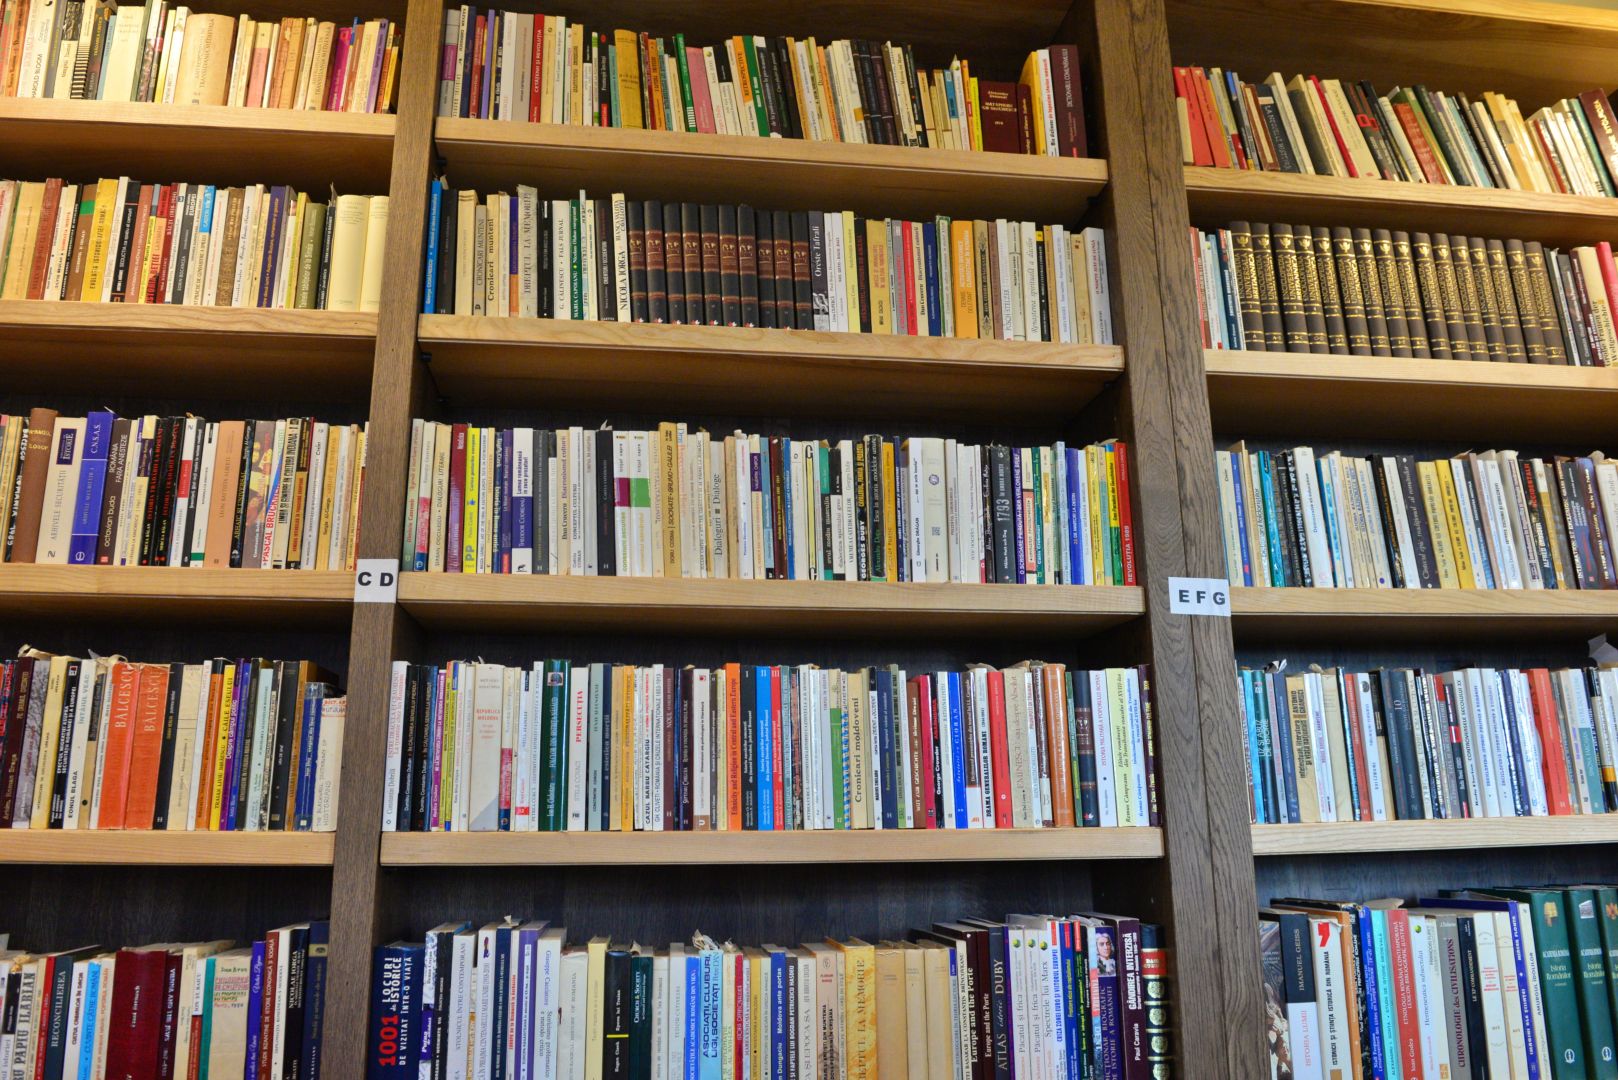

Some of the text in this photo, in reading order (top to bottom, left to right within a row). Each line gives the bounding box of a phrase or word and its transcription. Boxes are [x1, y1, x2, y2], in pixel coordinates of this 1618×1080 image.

[618, 251, 626, 276] IORGA
[812, 226, 822, 277] Oreste Tafrali
[90, 423, 101, 454] C.N.S.A.S.
[104, 496, 116, 547] octavian buda
[712, 473, 723, 555] Dialoguri Dialoge
[996, 498, 1009, 522] 1793
[1542, 548, 1550, 568] ALFRED
[358, 572, 394, 586] C D
[1178, 590, 1226, 606] E F G
[576, 690, 584, 743] PERSECUȚIA
[1393, 700, 1402, 711] 10
[226, 738, 234, 759] Despre
[852, 697, 862, 803] Cronicari moldoveni
[1265, 746, 1272, 756] DE
[70, 771, 78, 794] BLAGA
[730, 757, 738, 779] Religion
[730, 791, 738, 815] Ethnicity
[1122, 932, 1134, 970] INTERZISĂ
[1293, 928, 1305, 991] IMANUEL GEISS
[382, 957, 393, 1003] LOCURI
[390, 957, 402, 1003] ISTORICE
[994, 959, 1005, 994] DUBY
[1127, 972, 1137, 1010] GÂNDIREA
[50, 970, 66, 1047] RECONCILIEREA
[399, 957, 413, 1066] DE VIZITAT ÎNTR-O VIAȚĂ
[857, 959, 866, 1032] LA MEMORIE
[967, 994, 976, 1008] the
[1040, 961, 1052, 1038] Spectrele lui Marx
[1446, 939, 1466, 1068] CHRONOLOGIE des CIVILISATIONS
[13, 972, 36, 1065] PAPIU ILARIAN
[702, 1003, 712, 1058] ASOCIAȚII,
[968, 1011, 976, 1032] and
[378, 1015, 399, 1067] 1001
[970, 1034, 978, 1063] Europe
[984, 1035, 992, 1058] Europe
[997, 1033, 1008, 1070] ATLAS
